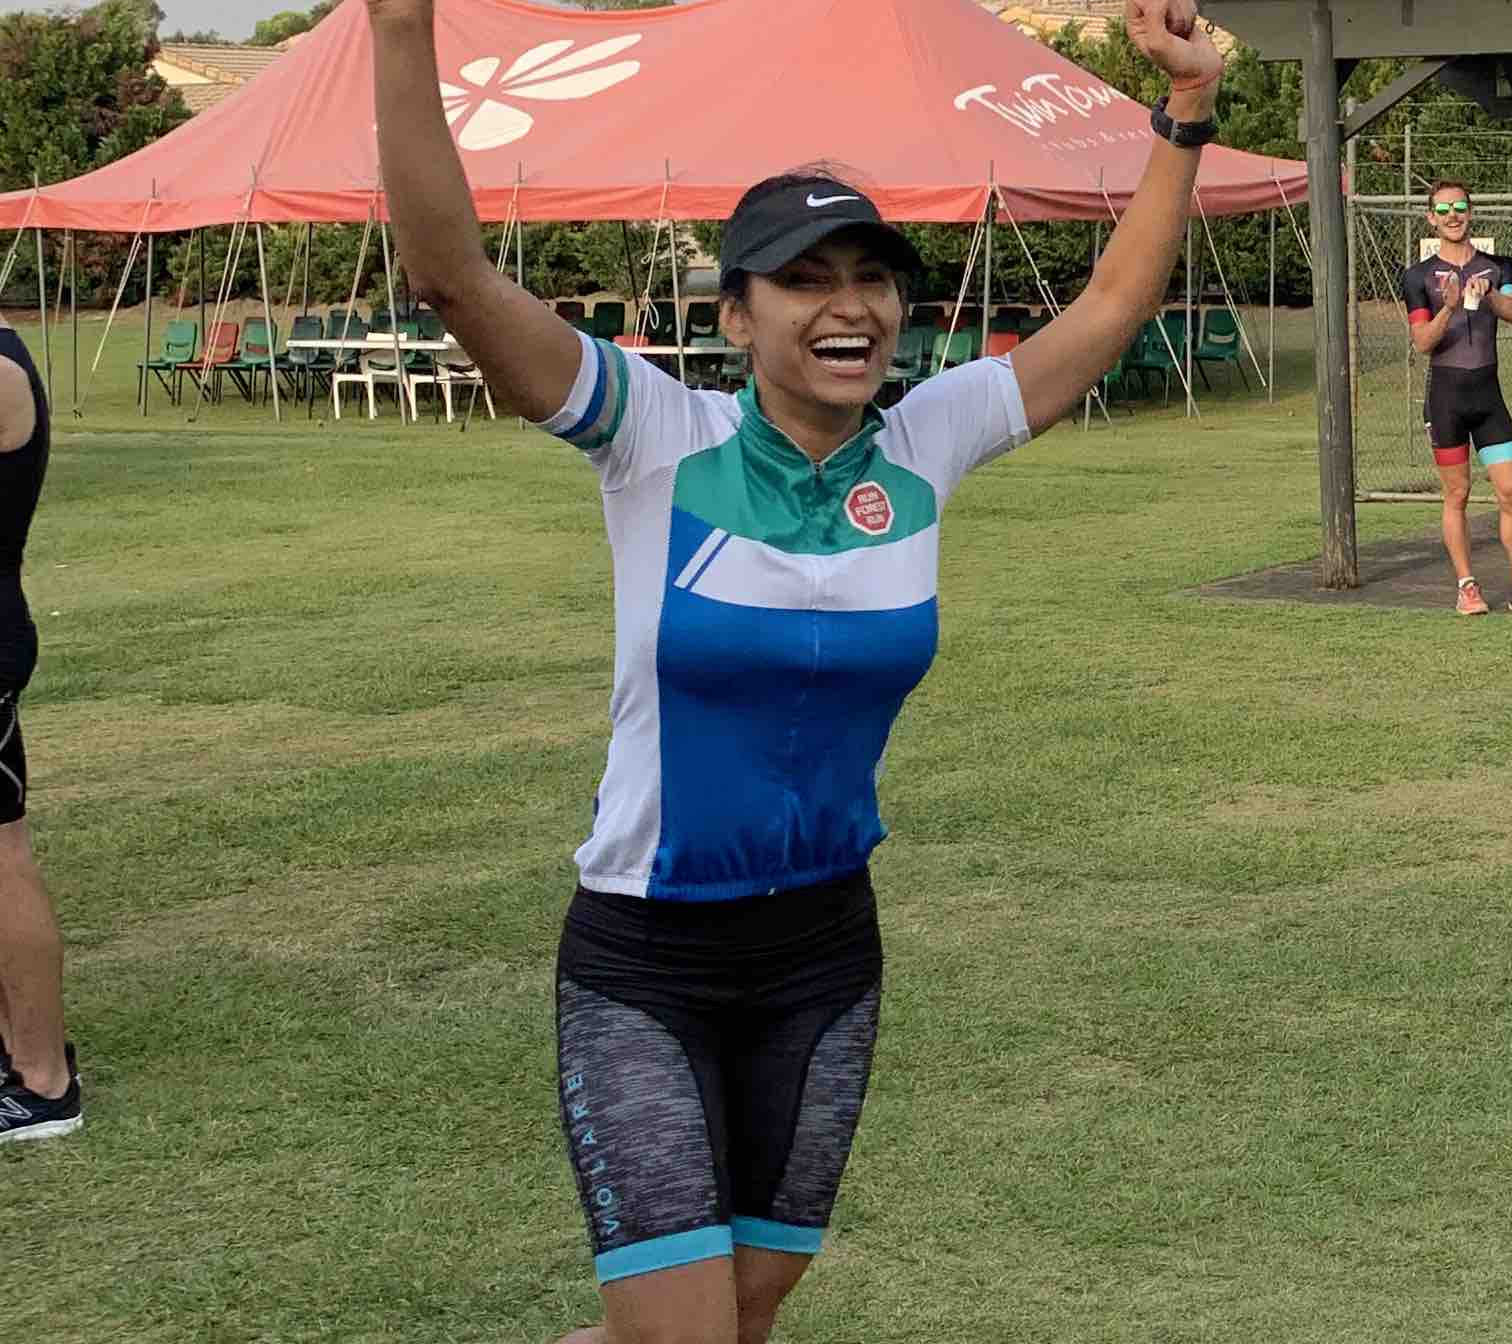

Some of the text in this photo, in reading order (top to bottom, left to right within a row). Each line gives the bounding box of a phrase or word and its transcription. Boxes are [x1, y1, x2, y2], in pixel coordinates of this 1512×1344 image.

[857, 490, 880, 504] RUN
[864, 514, 884, 525] RUN
[566, 1072, 620, 1235] VOLARE
